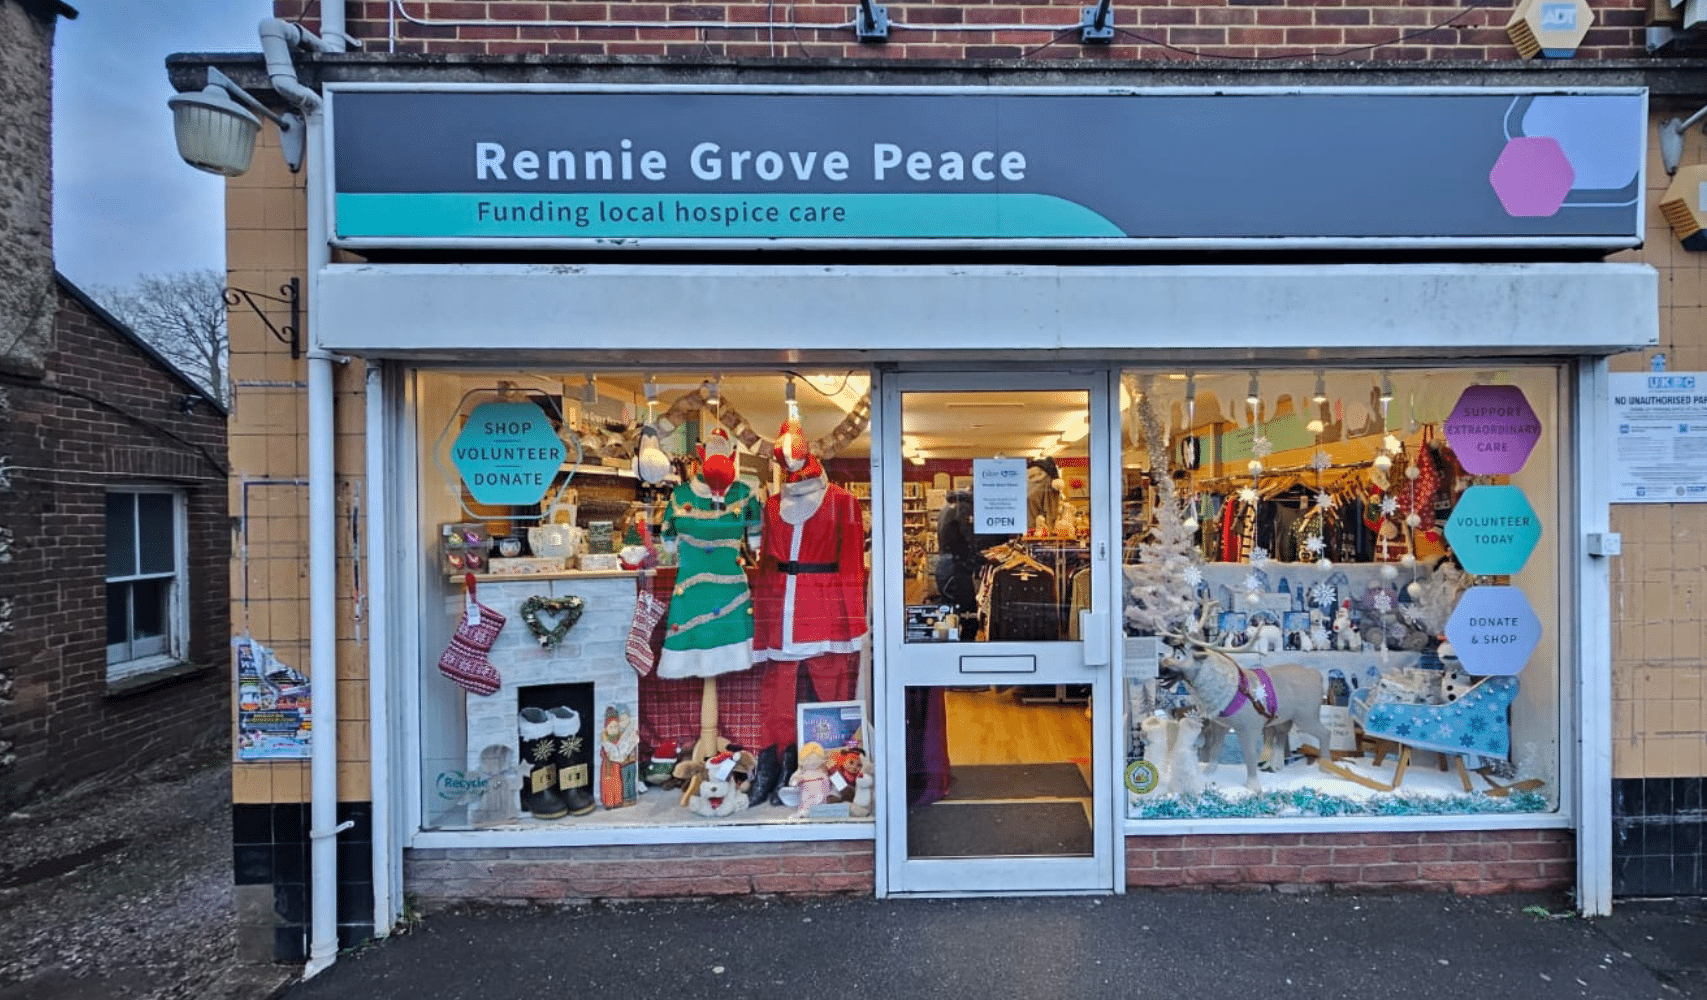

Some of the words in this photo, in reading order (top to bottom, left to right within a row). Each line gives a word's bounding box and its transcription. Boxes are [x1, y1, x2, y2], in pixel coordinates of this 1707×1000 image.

[1542, 8, 1576, 25] ADT
[476, 139, 667, 181] Rennie
[690, 142, 850, 181] Grove
[874, 142, 1027, 181] Peace
[478, 201, 589, 227] Funding
[600, 201, 664, 222] local
[675, 201, 779, 227] hospice
[790, 206, 846, 222] care
[1615, 396, 1626, 405] NO
[1629, 396, 1690, 405] UNAUTHORISED
[1463, 407, 1521, 418] SUPPORT
[485, 422, 531, 435] SHOP
[1447, 424, 1538, 435] EXTRAORDINARY
[1477, 442, 1508, 452] CARE
[456, 447, 559, 460] VOLUNTEER
[474, 473, 543, 486] DONATE
[986, 517, 1015, 527] OPEN
[1457, 516, 1531, 527] VOLUNTEER
[1475, 534, 1515, 544] TODAY
[1469, 617, 1519, 627] DONATE
[1471, 635, 1479, 645] &
[1484, 634, 1517, 644] SHOP
[444, 777, 488, 790] Recycle
